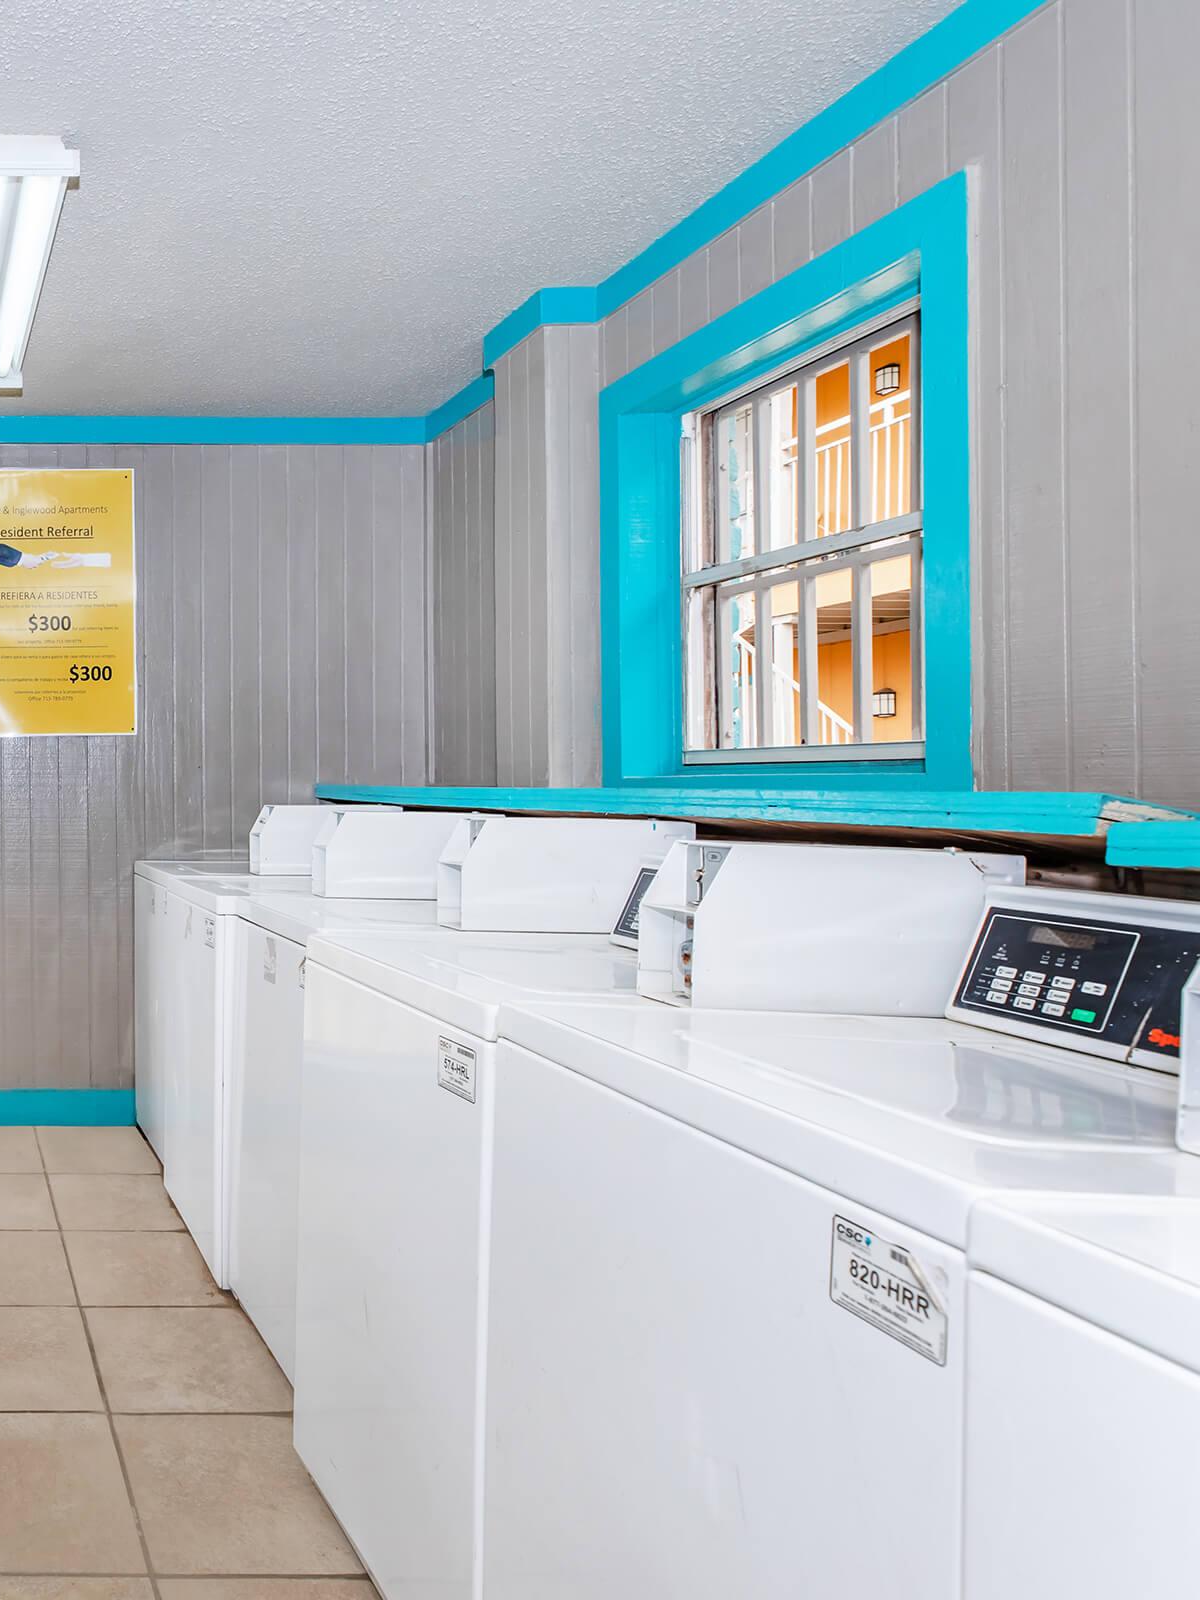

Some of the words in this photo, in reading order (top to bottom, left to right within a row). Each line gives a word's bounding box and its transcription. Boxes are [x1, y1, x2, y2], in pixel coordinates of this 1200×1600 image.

[3, 505, 9, 515] &
[12, 505, 57, 517] Inglewood
[58, 505, 109, 515] Apartments
[47, 525, 93, 537] Referral
[0, 591, 36, 600] REFIERA
[37, 591, 44, 600] A
[46, 590, 98, 600] RESIDENTES
[28, 613, 71, 634] $300
[69, 663, 112, 684] $300
[444, 1058, 470, 1080] 574-HRL
[836, 1223, 863, 1243] CSC
[849, 1258, 930, 1320] 820-HRR
